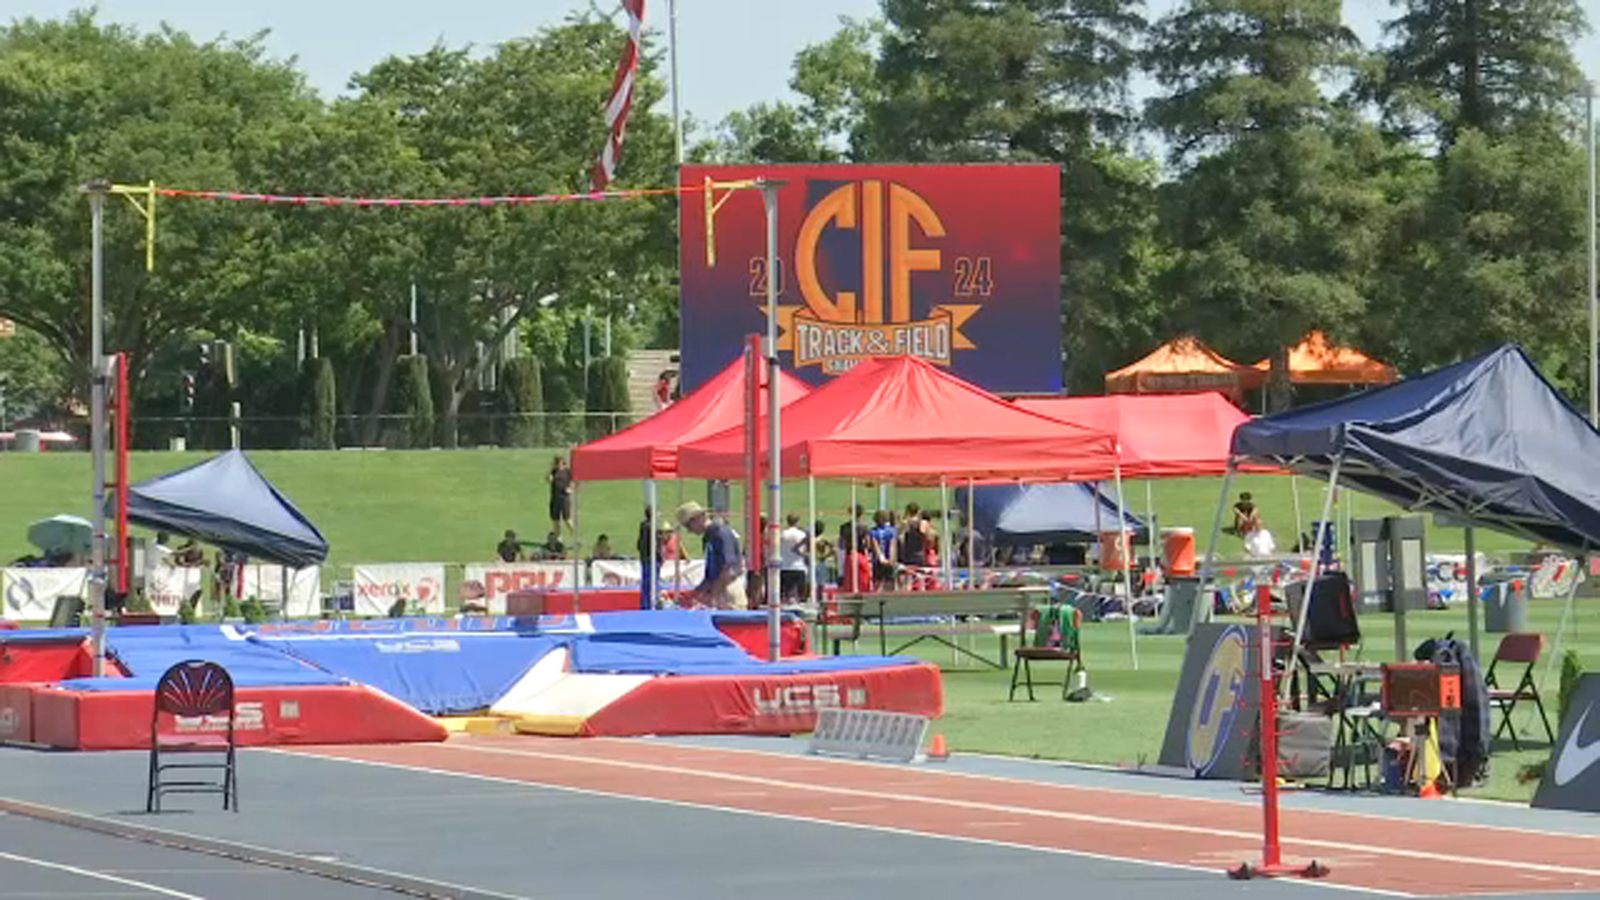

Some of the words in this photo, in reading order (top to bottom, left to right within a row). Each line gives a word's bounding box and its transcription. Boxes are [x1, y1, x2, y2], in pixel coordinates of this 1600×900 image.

[795, 180, 946, 323] CIF
[955, 257, 993, 296] 24
[799, 324, 862, 360] TRACK
[867, 329, 891, 355] &
[895, 324, 948, 360] FIELD
[358, 579, 411, 600] xerox
[753, 685, 841, 710] UCS
